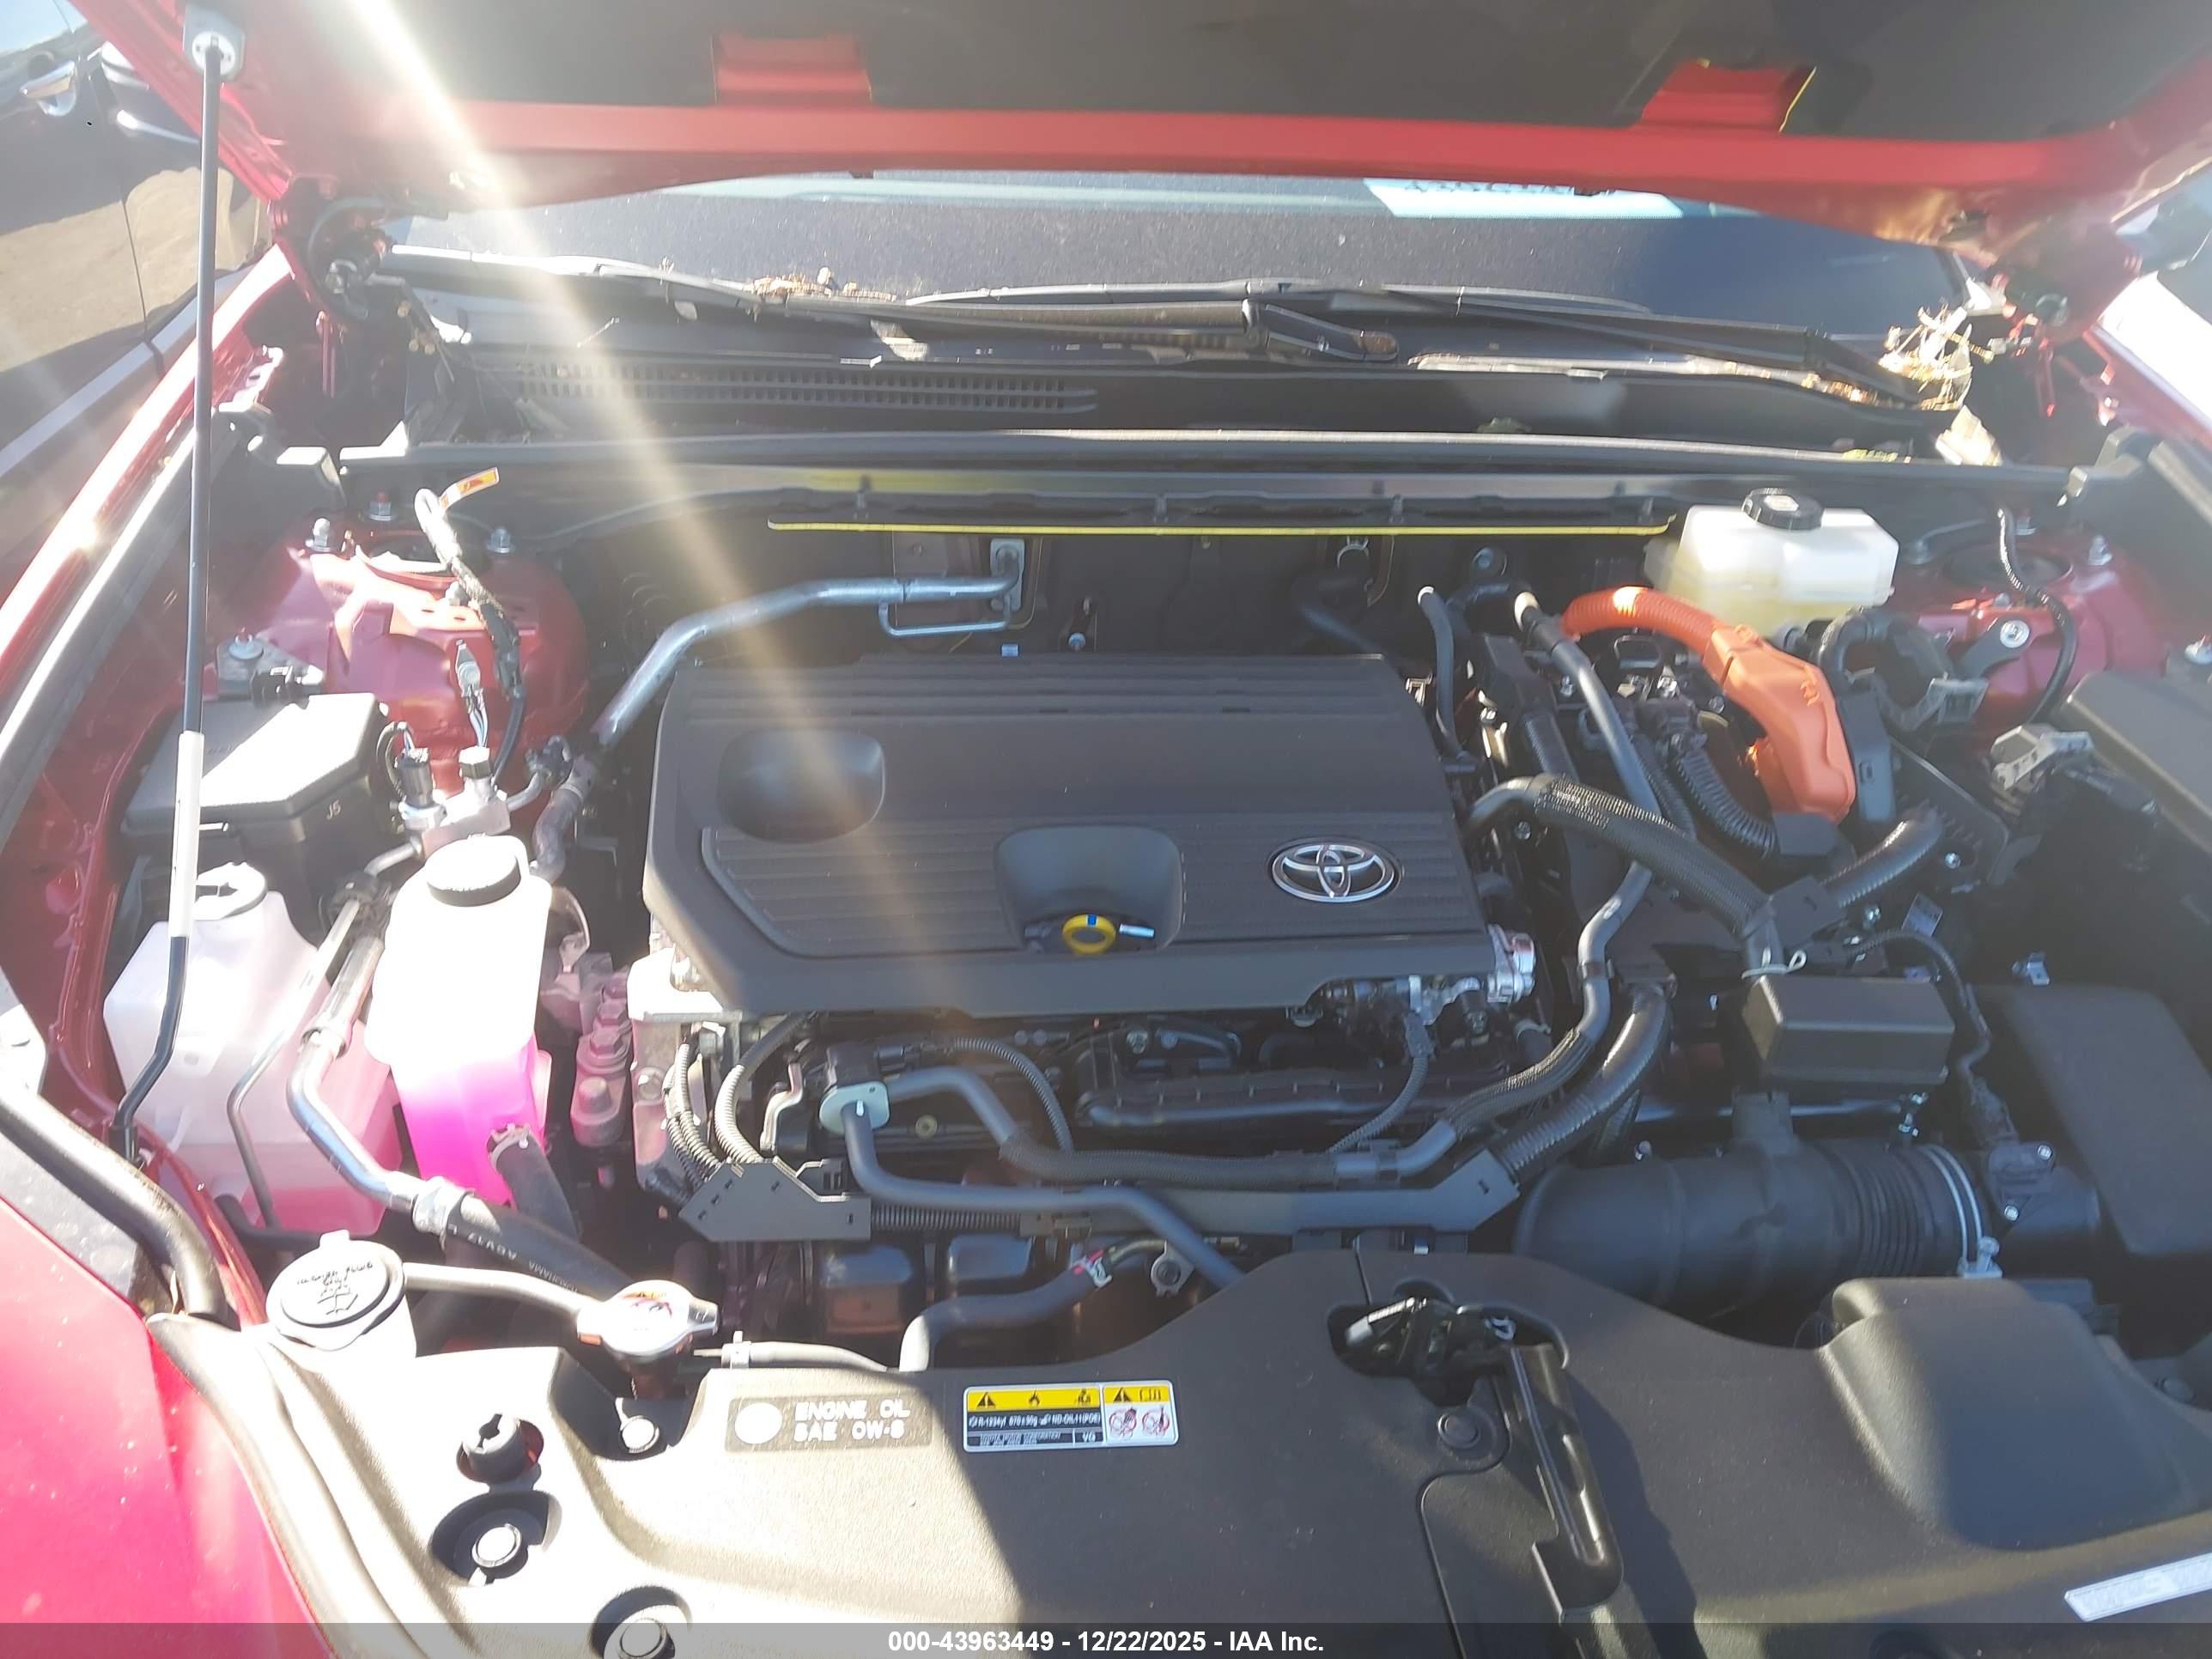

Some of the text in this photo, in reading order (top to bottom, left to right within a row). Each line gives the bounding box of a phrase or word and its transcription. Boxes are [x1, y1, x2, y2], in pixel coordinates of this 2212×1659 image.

[794, 1398, 910, 1421] ENGINE OIL
[793, 1421, 838, 1442] SAE
